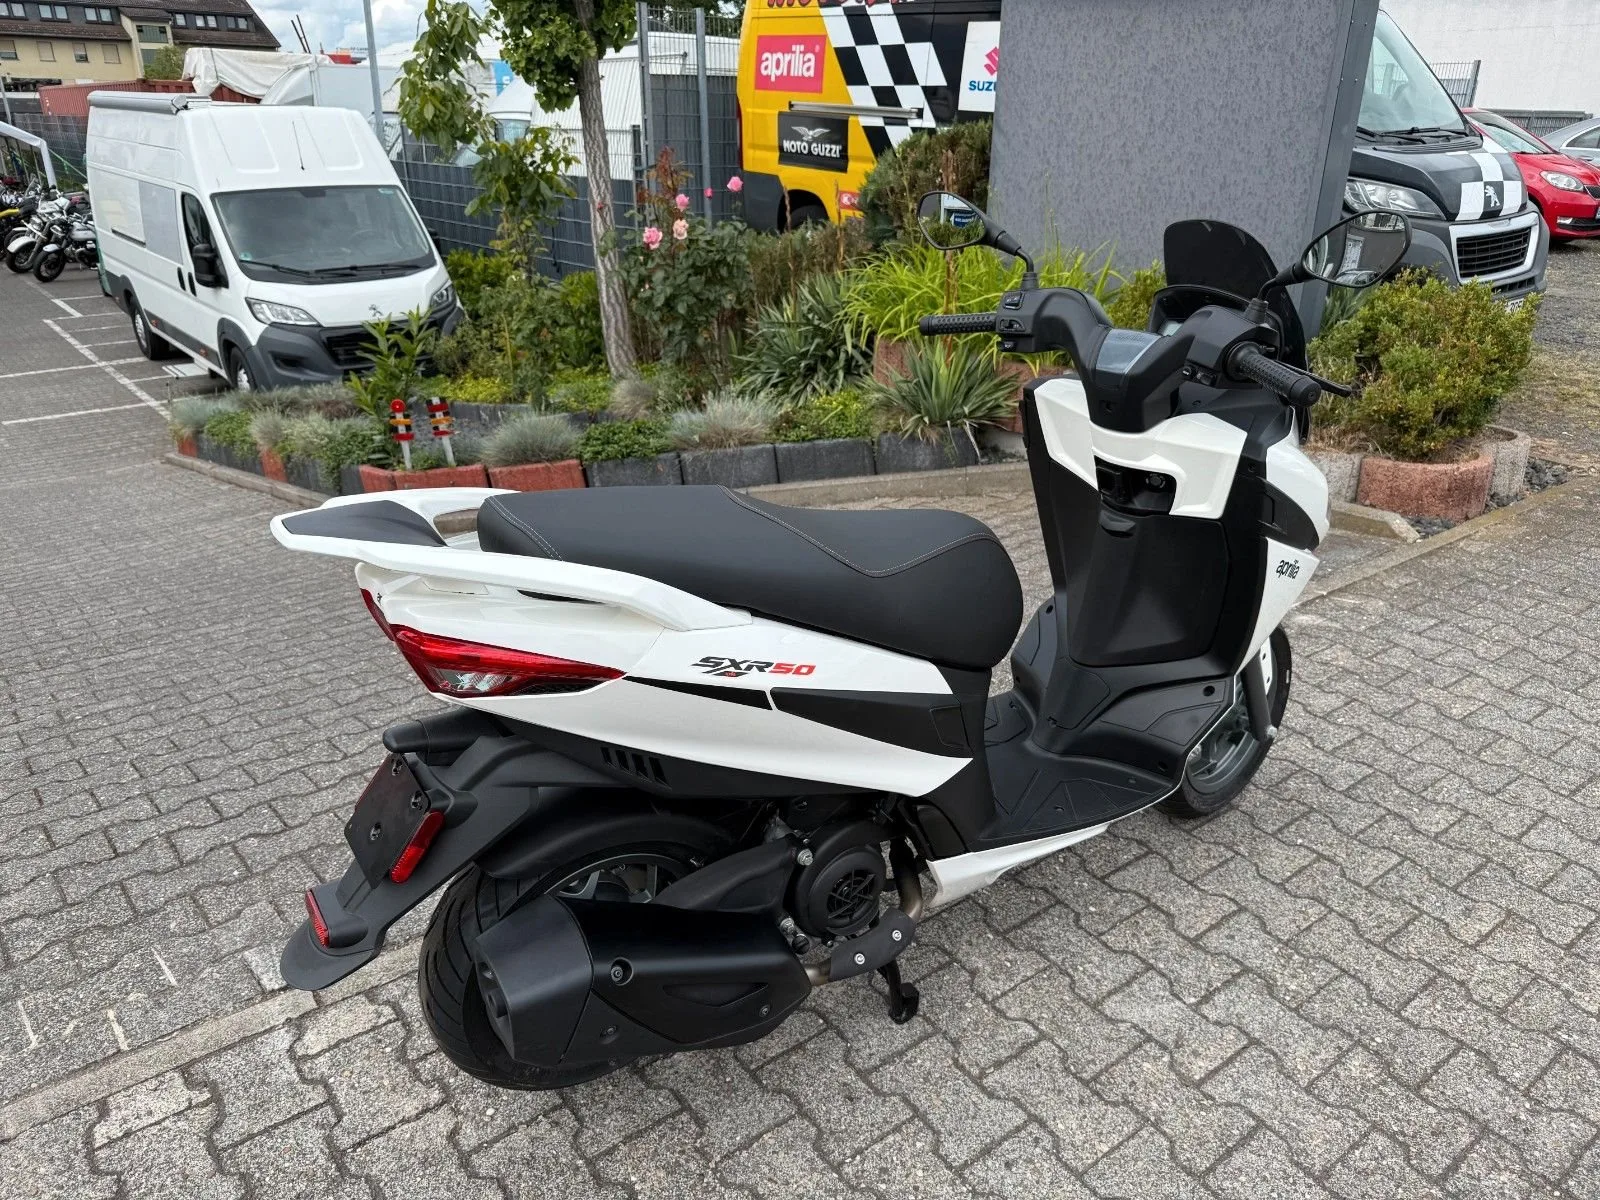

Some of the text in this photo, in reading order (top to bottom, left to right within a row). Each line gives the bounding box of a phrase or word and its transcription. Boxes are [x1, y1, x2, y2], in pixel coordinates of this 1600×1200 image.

[760, 44, 815, 82] aprilia
[783, 139, 840, 158] MOTO GUZZI
[1276, 559, 1300, 579] aprilia
